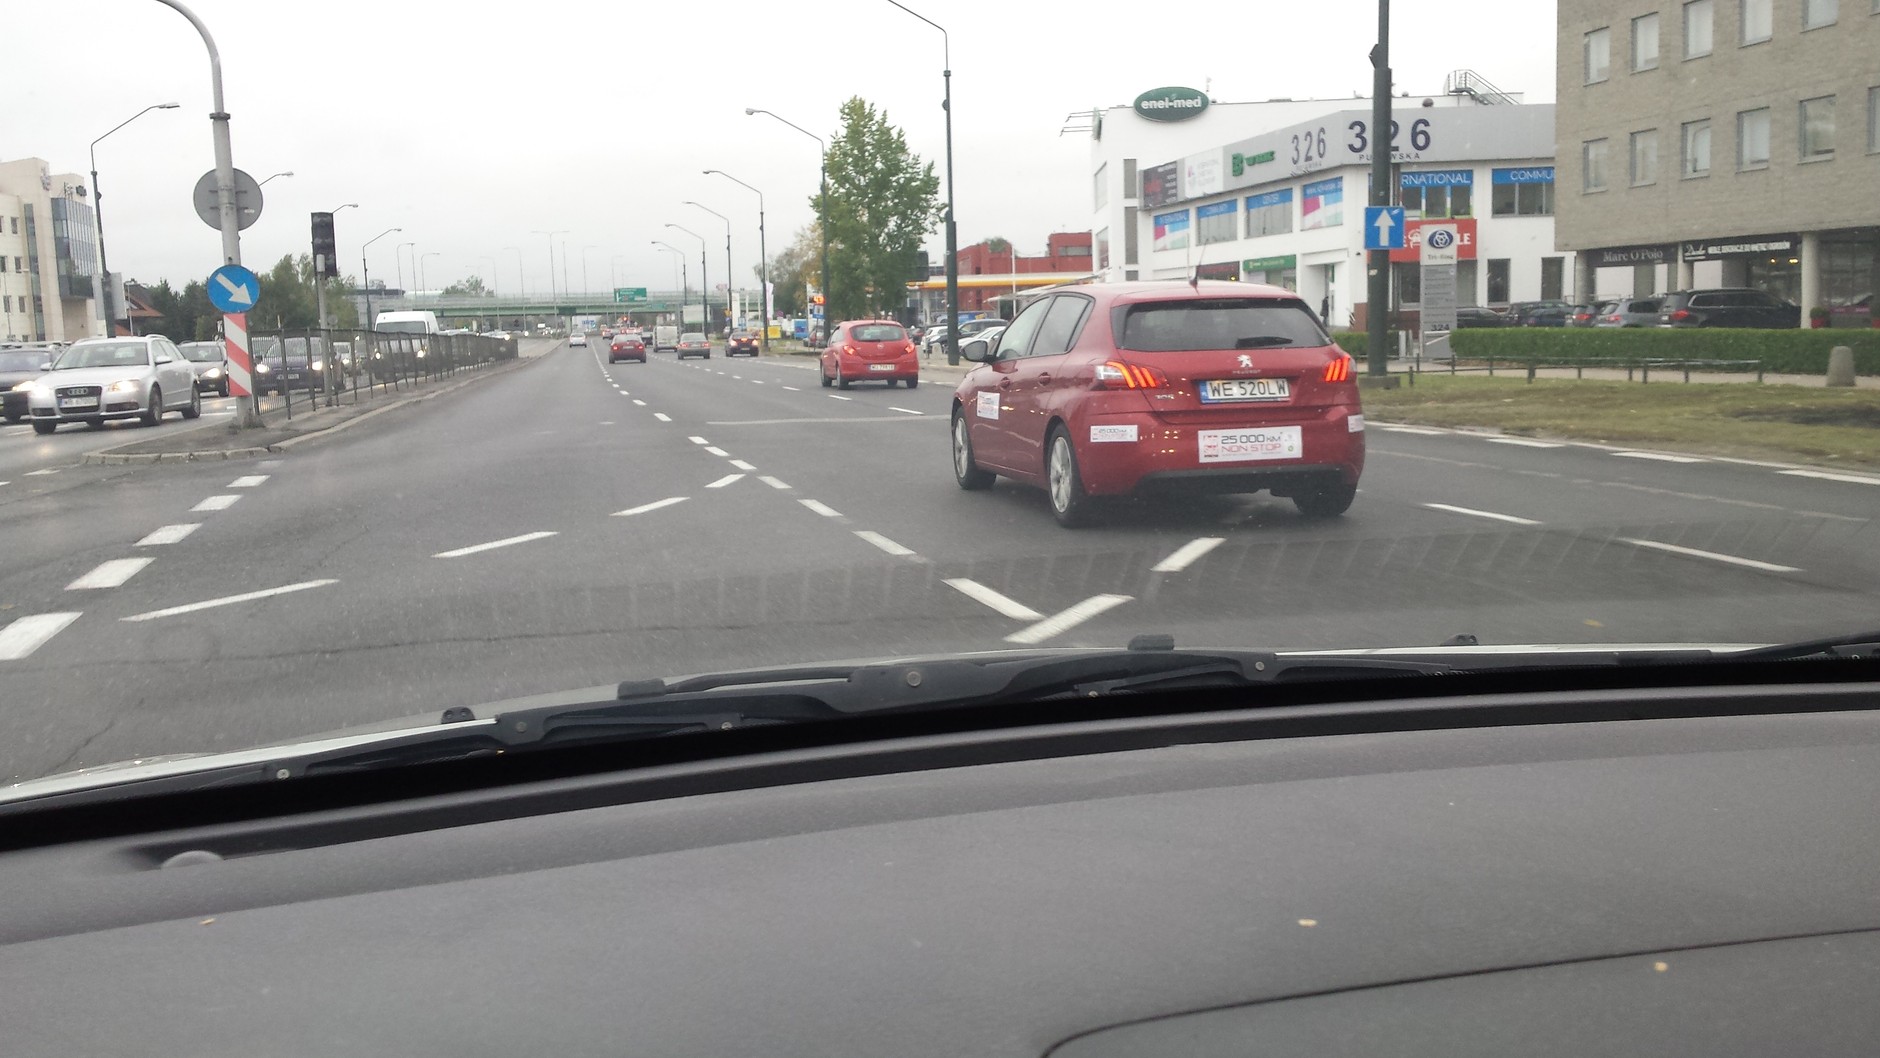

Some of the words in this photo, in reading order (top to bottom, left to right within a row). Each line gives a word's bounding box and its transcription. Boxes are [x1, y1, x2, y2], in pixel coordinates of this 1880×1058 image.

[1140, 96, 1202, 109] enel-med
[1291, 127, 1327, 165] 326
[1359, 153, 1420, 161] PUWSKA
[1402, 173, 1470, 185] RNATIONAL
[1510, 170, 1555, 181] COMMU
[1603, 251, 1629, 262] Marc
[1210, 382, 1233, 397] WE
[1238, 380, 1286, 396] 520LW
[1221, 435, 1238, 444] 25
[1239, 434, 1266, 444] 000
[1250, 443, 1282, 451] STOP
